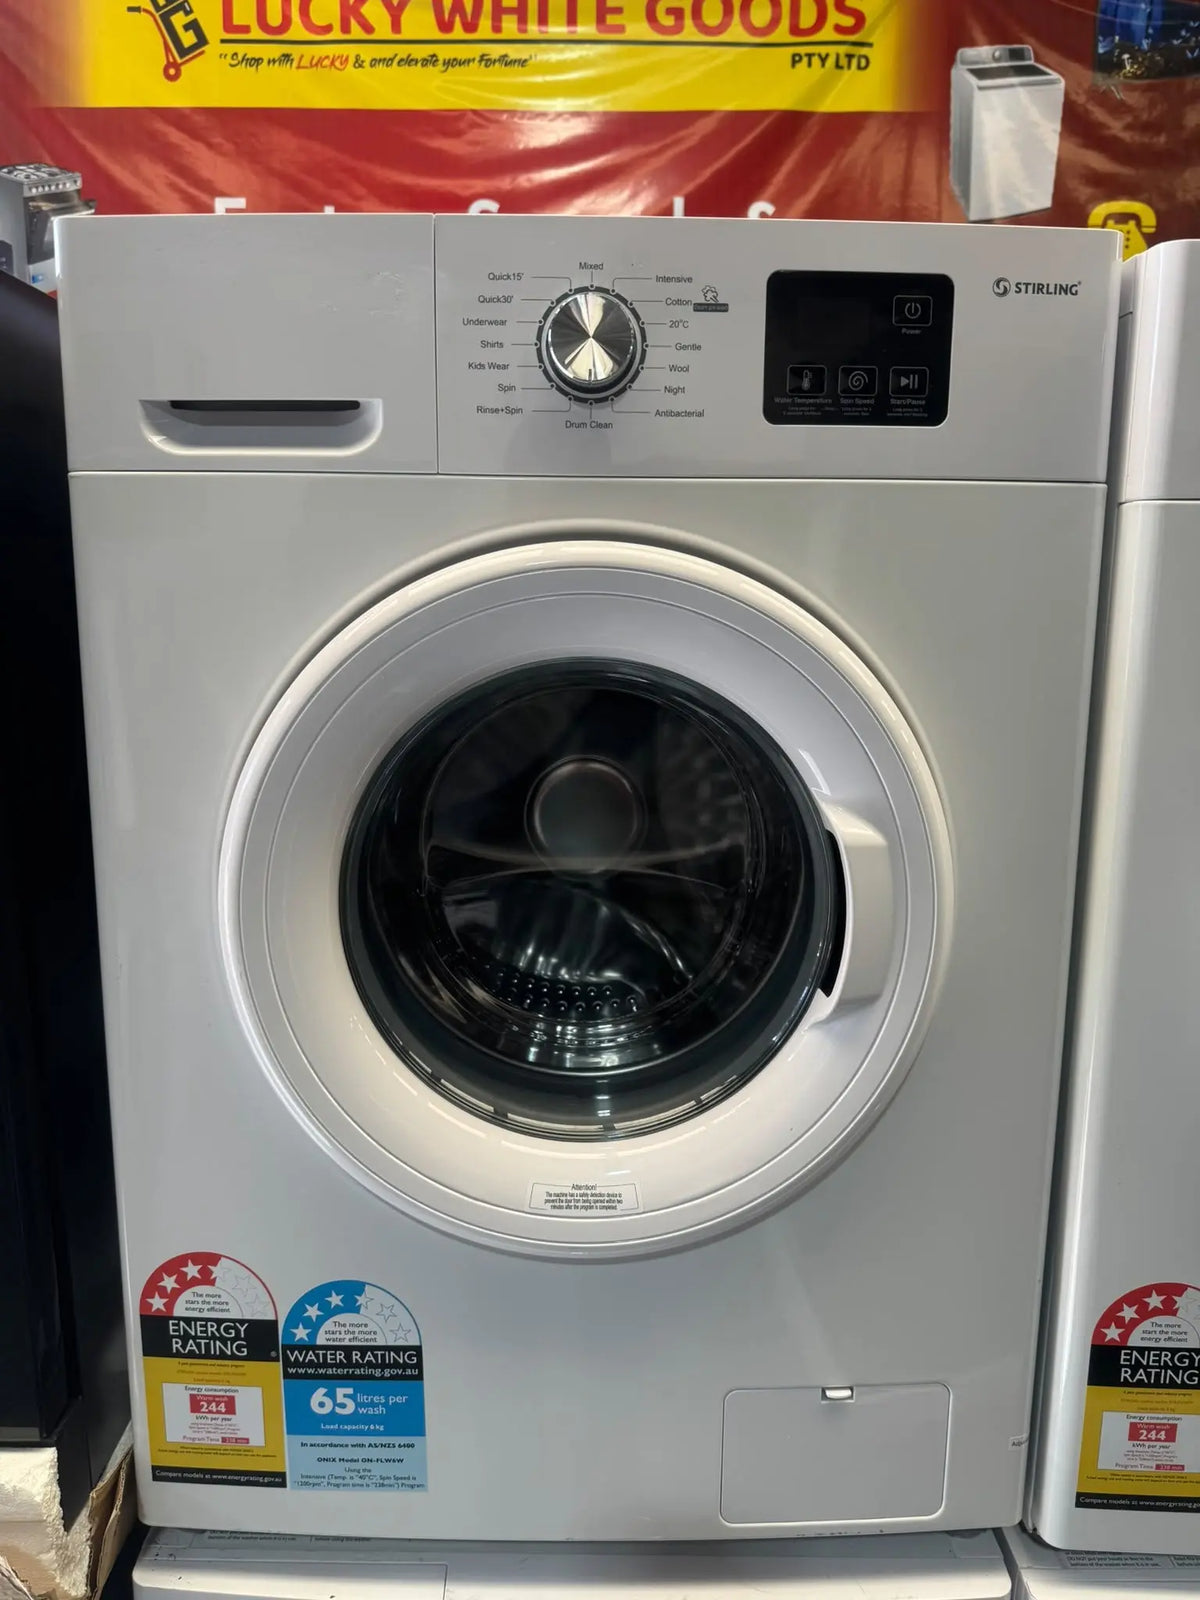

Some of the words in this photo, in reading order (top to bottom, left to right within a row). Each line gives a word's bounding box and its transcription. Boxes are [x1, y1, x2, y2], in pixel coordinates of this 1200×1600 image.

[222, 0, 410, 36] LUCKY
[432, 0, 626, 35] WHITE
[645, 0, 867, 37] GOODS
[267, 53, 294, 68] with
[295, 54, 349, 71] LUCKY
[353, 55, 365, 69] &
[369, 53, 398, 69] and
[397, 53, 439, 68] elevate
[440, 57, 475, 73] your
[791, 53, 829, 69] PTY
[835, 53, 870, 70] LTD
[579, 262, 604, 270] Mixed
[488, 272, 524, 281] Quick15'
[656, 275, 693, 283] Intensive
[478, 295, 514, 304] Quick30'
[665, 298, 693, 306] Cotton
[462, 318, 507, 326] Underwear
[669, 320, 689, 329] 20°C
[480, 340, 504, 348] Shirts
[675, 342, 702, 351] Gentle
[468, 362, 486, 370] Kids
[488, 362, 510, 370] Wear
[498, 384, 516, 393] Spin
[664, 386, 686, 395] Night
[476, 406, 523, 415] Rinse+Spin
[654, 409, 705, 418] Antibacterial
[565, 421, 588, 429] Drum
[589, 421, 613, 429] Clean
[571, 1183, 597, 1191] Attention!
[168, 1320, 249, 1338] ENERGY
[171, 1338, 248, 1356] RATING
[287, 1350, 347, 1363] WATER
[352, 1350, 418, 1364] RATING
[1120, 1349, 1200, 1367] ENERGY
[287, 1366, 419, 1377] www.waterrating.gov.au
[1120, 1367, 1200, 1385] RATING
[184, 1385, 203, 1393] Energy
[310, 1387, 356, 1415] 65
[357, 1393, 386, 1403] litres
[389, 1395, 408, 1405] per
[199, 1401, 227, 1413] 244
[357, 1405, 386, 1415] wash
[340, 1423, 369, 1431] capacity
[1138, 1429, 1167, 1441] 244
[1079, 1496, 1107, 1505] Compare
